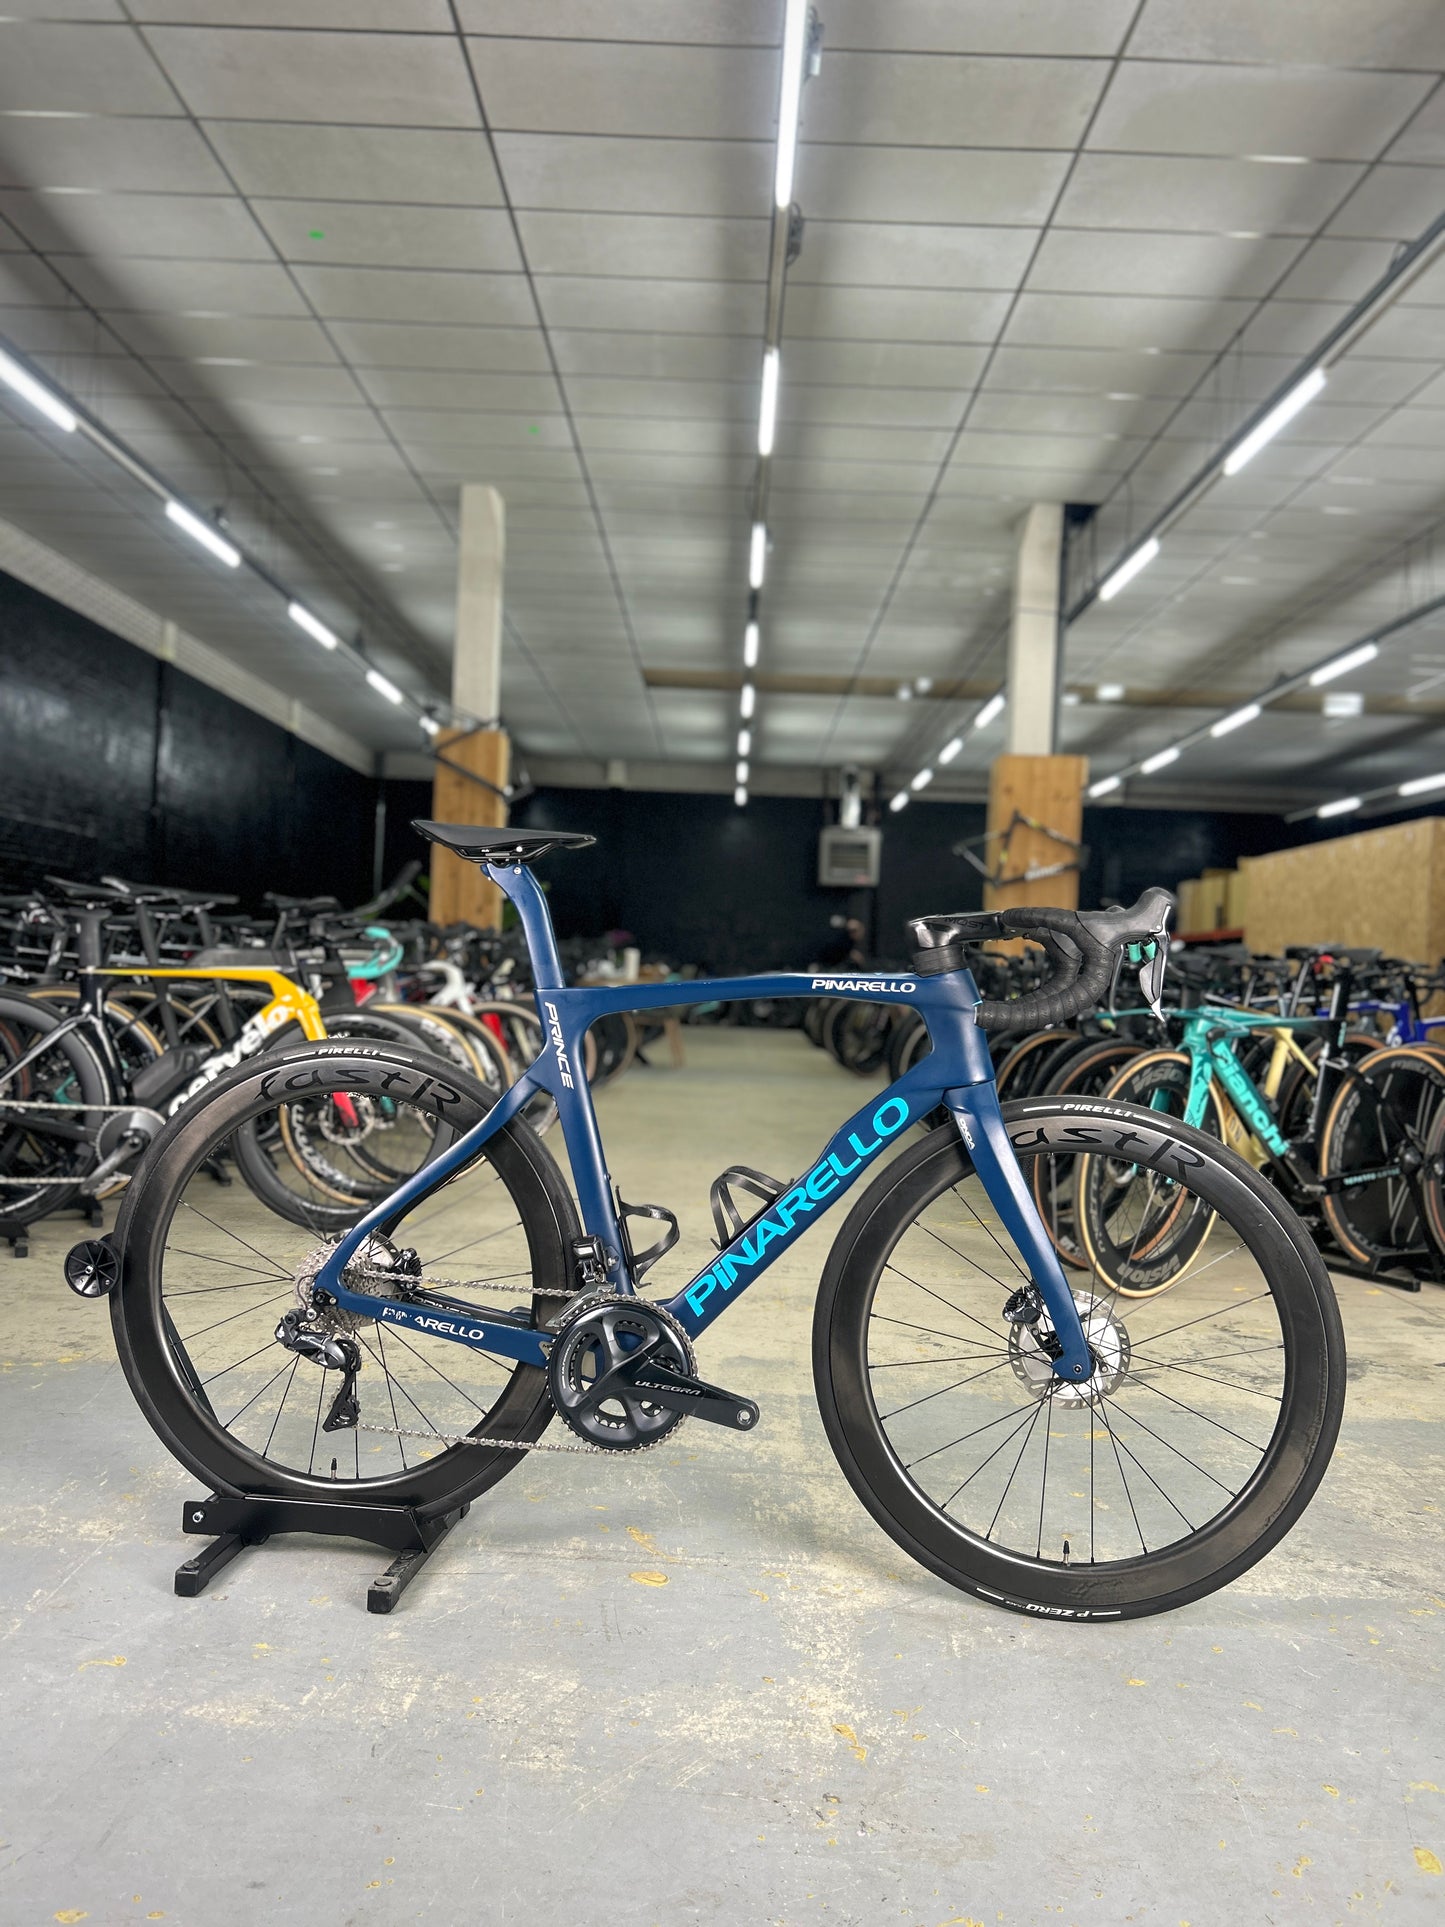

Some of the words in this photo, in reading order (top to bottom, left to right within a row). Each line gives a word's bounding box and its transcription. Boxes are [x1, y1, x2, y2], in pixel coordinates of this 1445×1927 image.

[811, 979, 917, 993] PINARELLO
[317, 1047, 380, 1056] PIRELLI
[544, 1001, 575, 1090] PRINCE
[1063, 1103, 1135, 1118] PIRELLI
[959, 1118, 976, 1151] ONDA
[684, 1097, 910, 1318] PINARELLO
[634, 1380, 702, 1396] ULTEGRA
[1025, 1603, 1075, 1617] ZERO
[1076, 1610, 1090, 1618] P
